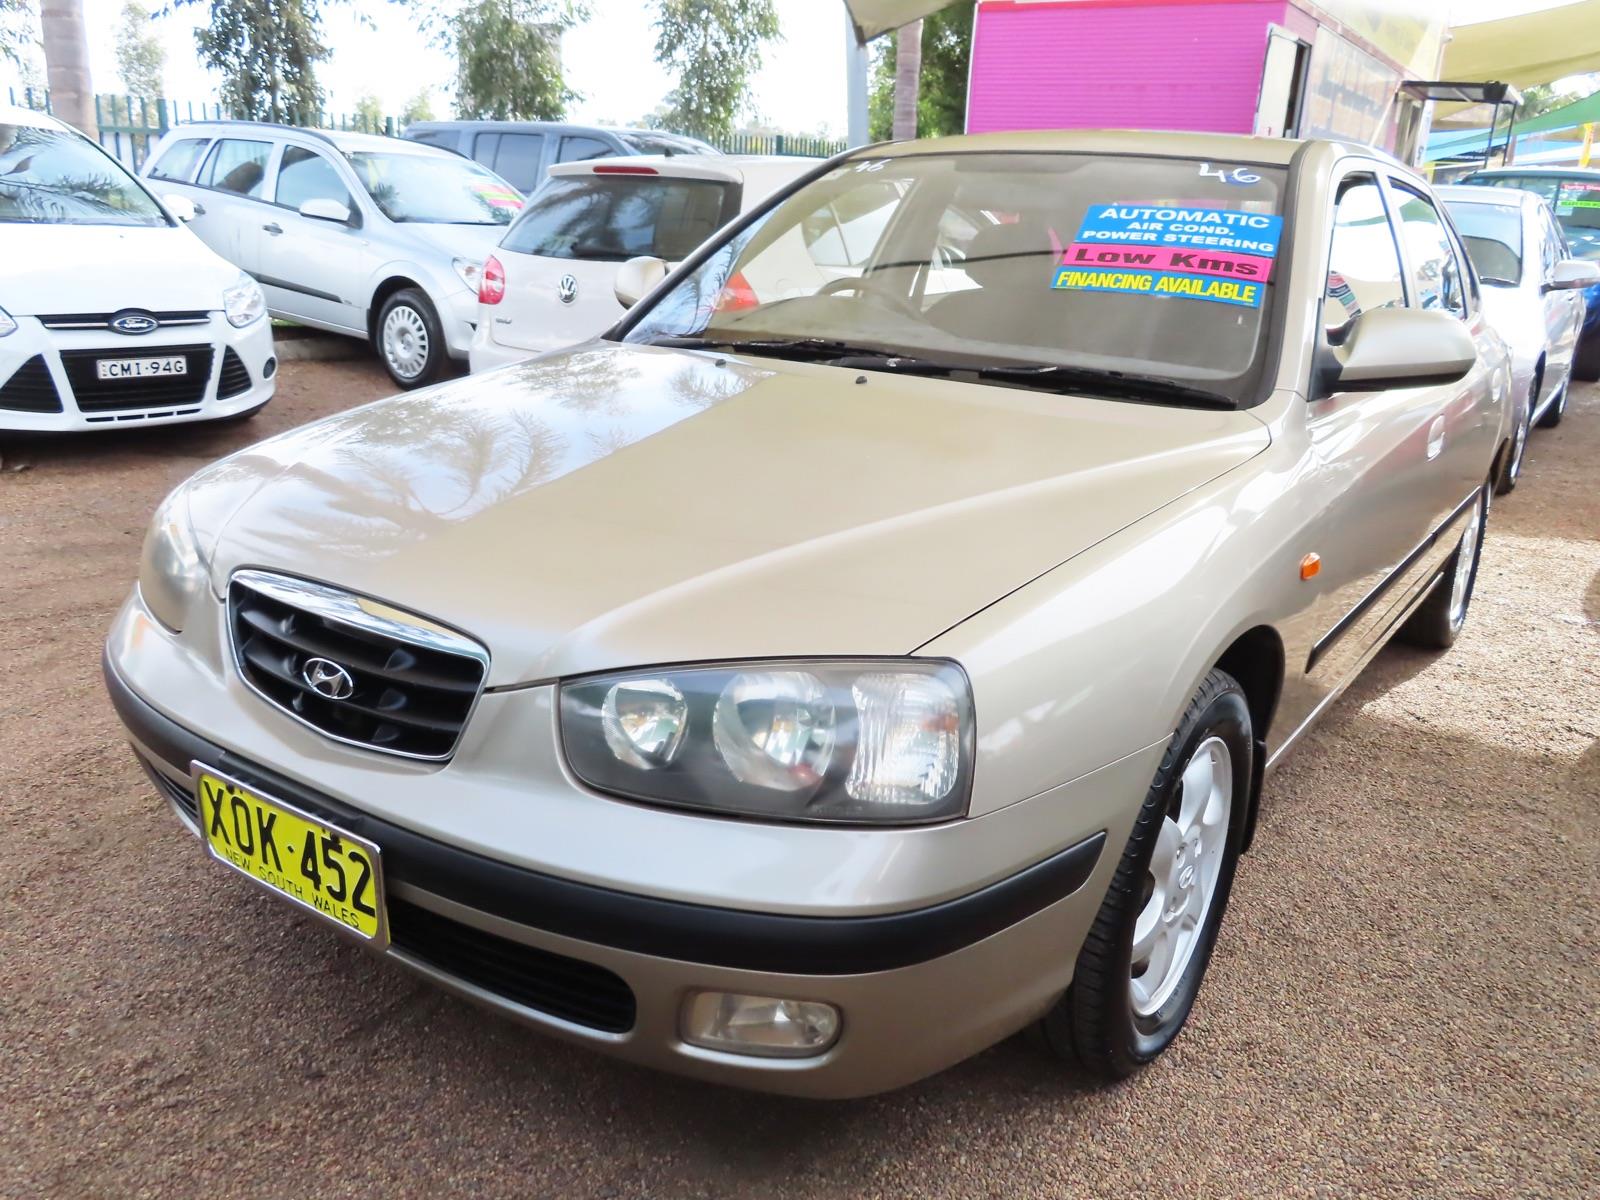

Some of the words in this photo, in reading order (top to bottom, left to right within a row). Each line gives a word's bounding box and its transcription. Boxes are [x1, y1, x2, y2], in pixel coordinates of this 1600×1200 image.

[1199, 163, 1261, 183] 46
[1099, 208, 1270, 229] AUTOMATIC
[1127, 221, 1164, 231] AIR
[1169, 223, 1235, 236] COND.
[1082, 230, 1158, 242] POWER
[1163, 232, 1274, 252] STEERING
[1075, 248, 1157, 265] Low
[1169, 252, 1259, 276] Kms
[1056, 271, 1153, 291] FINANCING
[1154, 275, 1256, 303] AVAILABLE
[225, 849, 251, 872] NEW
[259, 866, 303, 900] SOUTH
[312, 892, 361, 929] WALES
